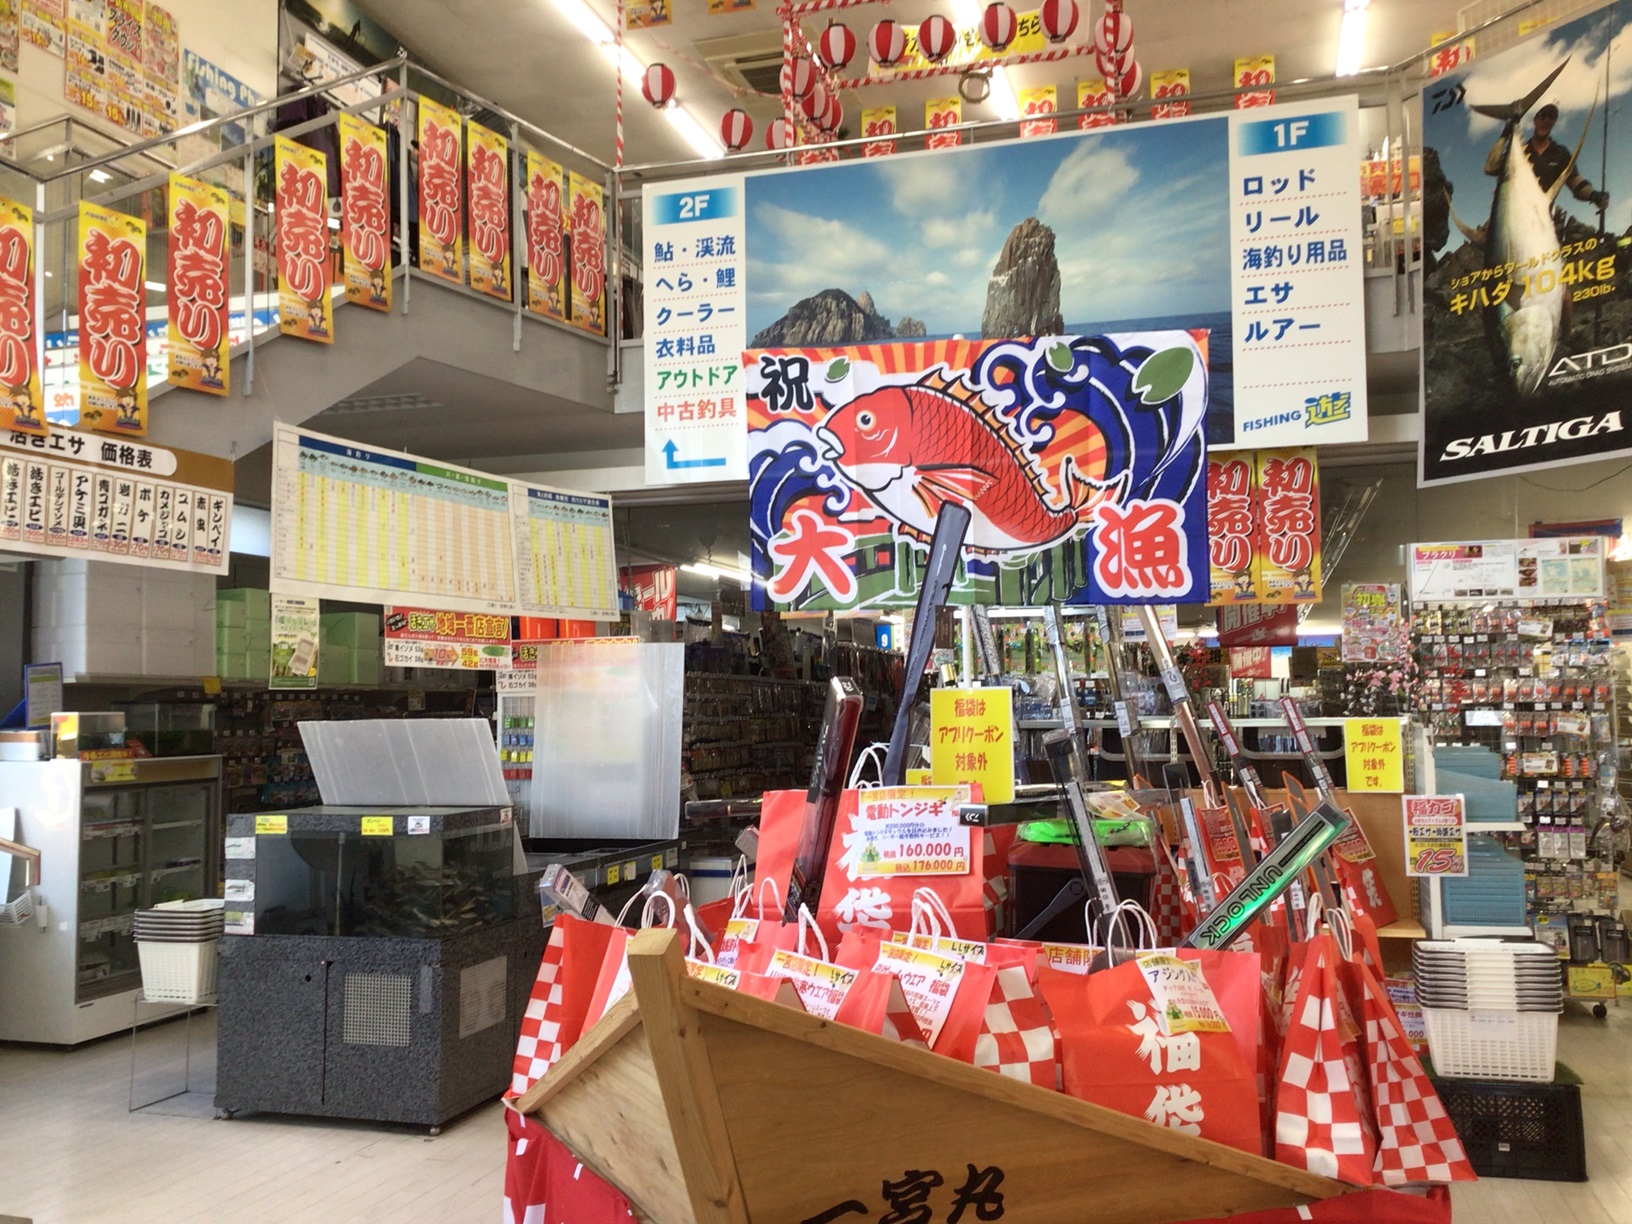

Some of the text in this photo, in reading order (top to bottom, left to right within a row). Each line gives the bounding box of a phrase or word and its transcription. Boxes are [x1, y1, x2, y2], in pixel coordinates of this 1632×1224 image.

[1274, 120, 1310, 148] 1F
[420, 118, 458, 246] 初売り
[1243, 168, 1317, 196] ロッド
[343, 136, 387, 272] 初売り
[470, 141, 506, 264] 初売り
[679, 194, 710, 219] 2F
[279, 159, 325, 301] 初売り
[530, 169, 562, 287] 初売り
[1245, 206, 1321, 233] リール
[572, 191, 603, 302] 初売り
[654, 234, 736, 263] 鮎・渓流
[1242, 238, 1348, 271] 海釣り用品
[172, 198, 226, 351] 初売り
[1450, 237, 1599, 291] ショアからワールドクラスの
[655, 268, 736, 292] へら・鯉
[1244, 282, 1295, 305] エサ
[1449, 254, 1617, 316] キハダ 104kg
[83, 228, 144, 391] 初売り
[656, 303, 736, 327] クーラー
[1244, 318, 1322, 344] ルアー
[656, 334, 716, 359] 衣料品
[657, 365, 739, 391] アウトドア
[760, 355, 815, 413] 祝
[657, 397, 738, 423] 中古釣具
[1242, 390, 1352, 433] FISHING 遊
[1439, 409, 1625, 463] SALTIGA
[100, 441, 153, 469] 価格表
[28, 466, 44, 522] 活きエビ
[72, 475, 89, 530] アケミ貝
[1262, 457, 1315, 573] 初売り
[771, 516, 855, 598] 大
[1097, 504, 1188, 591] 漁
[954, 698, 986, 718] 福袋は
[938, 725, 1004, 743] アプリクーポン
[1361, 724, 1384, 737] 福袋は
[955, 752, 988, 771] 対象外
[1350, 741, 1397, 754] アプリクーポン
[1362, 758, 1386, 771] 対象外
[865, 802, 944, 821] 電動トンジギ
[1411, 799, 1457, 817] 福カゴ
[954, 846, 964, 857] 円
[1414, 848, 1458, 874] 15
[955, 862, 966, 871] 円
[1200, 864, 1283, 947] UNLOCK
